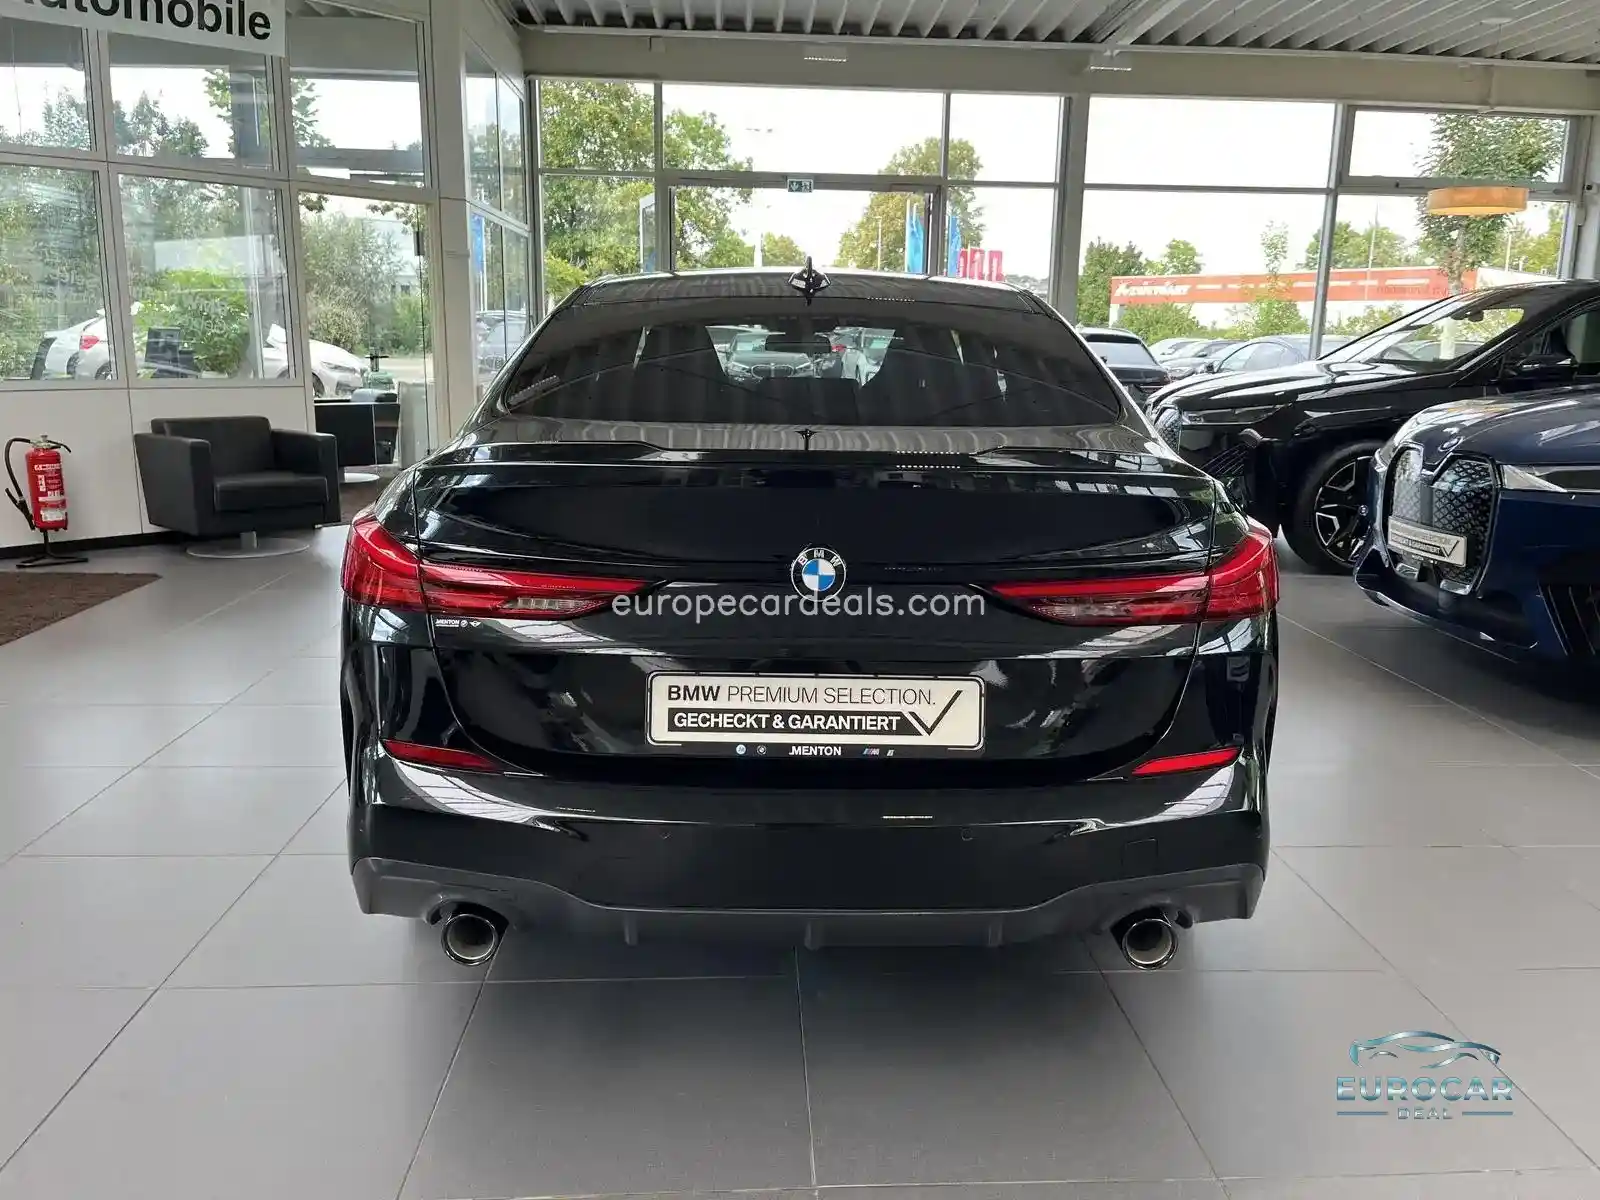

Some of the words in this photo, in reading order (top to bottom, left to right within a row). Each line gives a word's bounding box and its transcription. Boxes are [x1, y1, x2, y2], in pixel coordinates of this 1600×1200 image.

[23, 0, 271, 40] omobile
[798, 549, 841, 566] BMW
[668, 685, 720, 701] BMW
[728, 685, 817, 703] PREMIUM
[674, 712, 770, 729] GECHECKT
[772, 714, 785, 729] &
[788, 714, 901, 731] GARANTIERT
